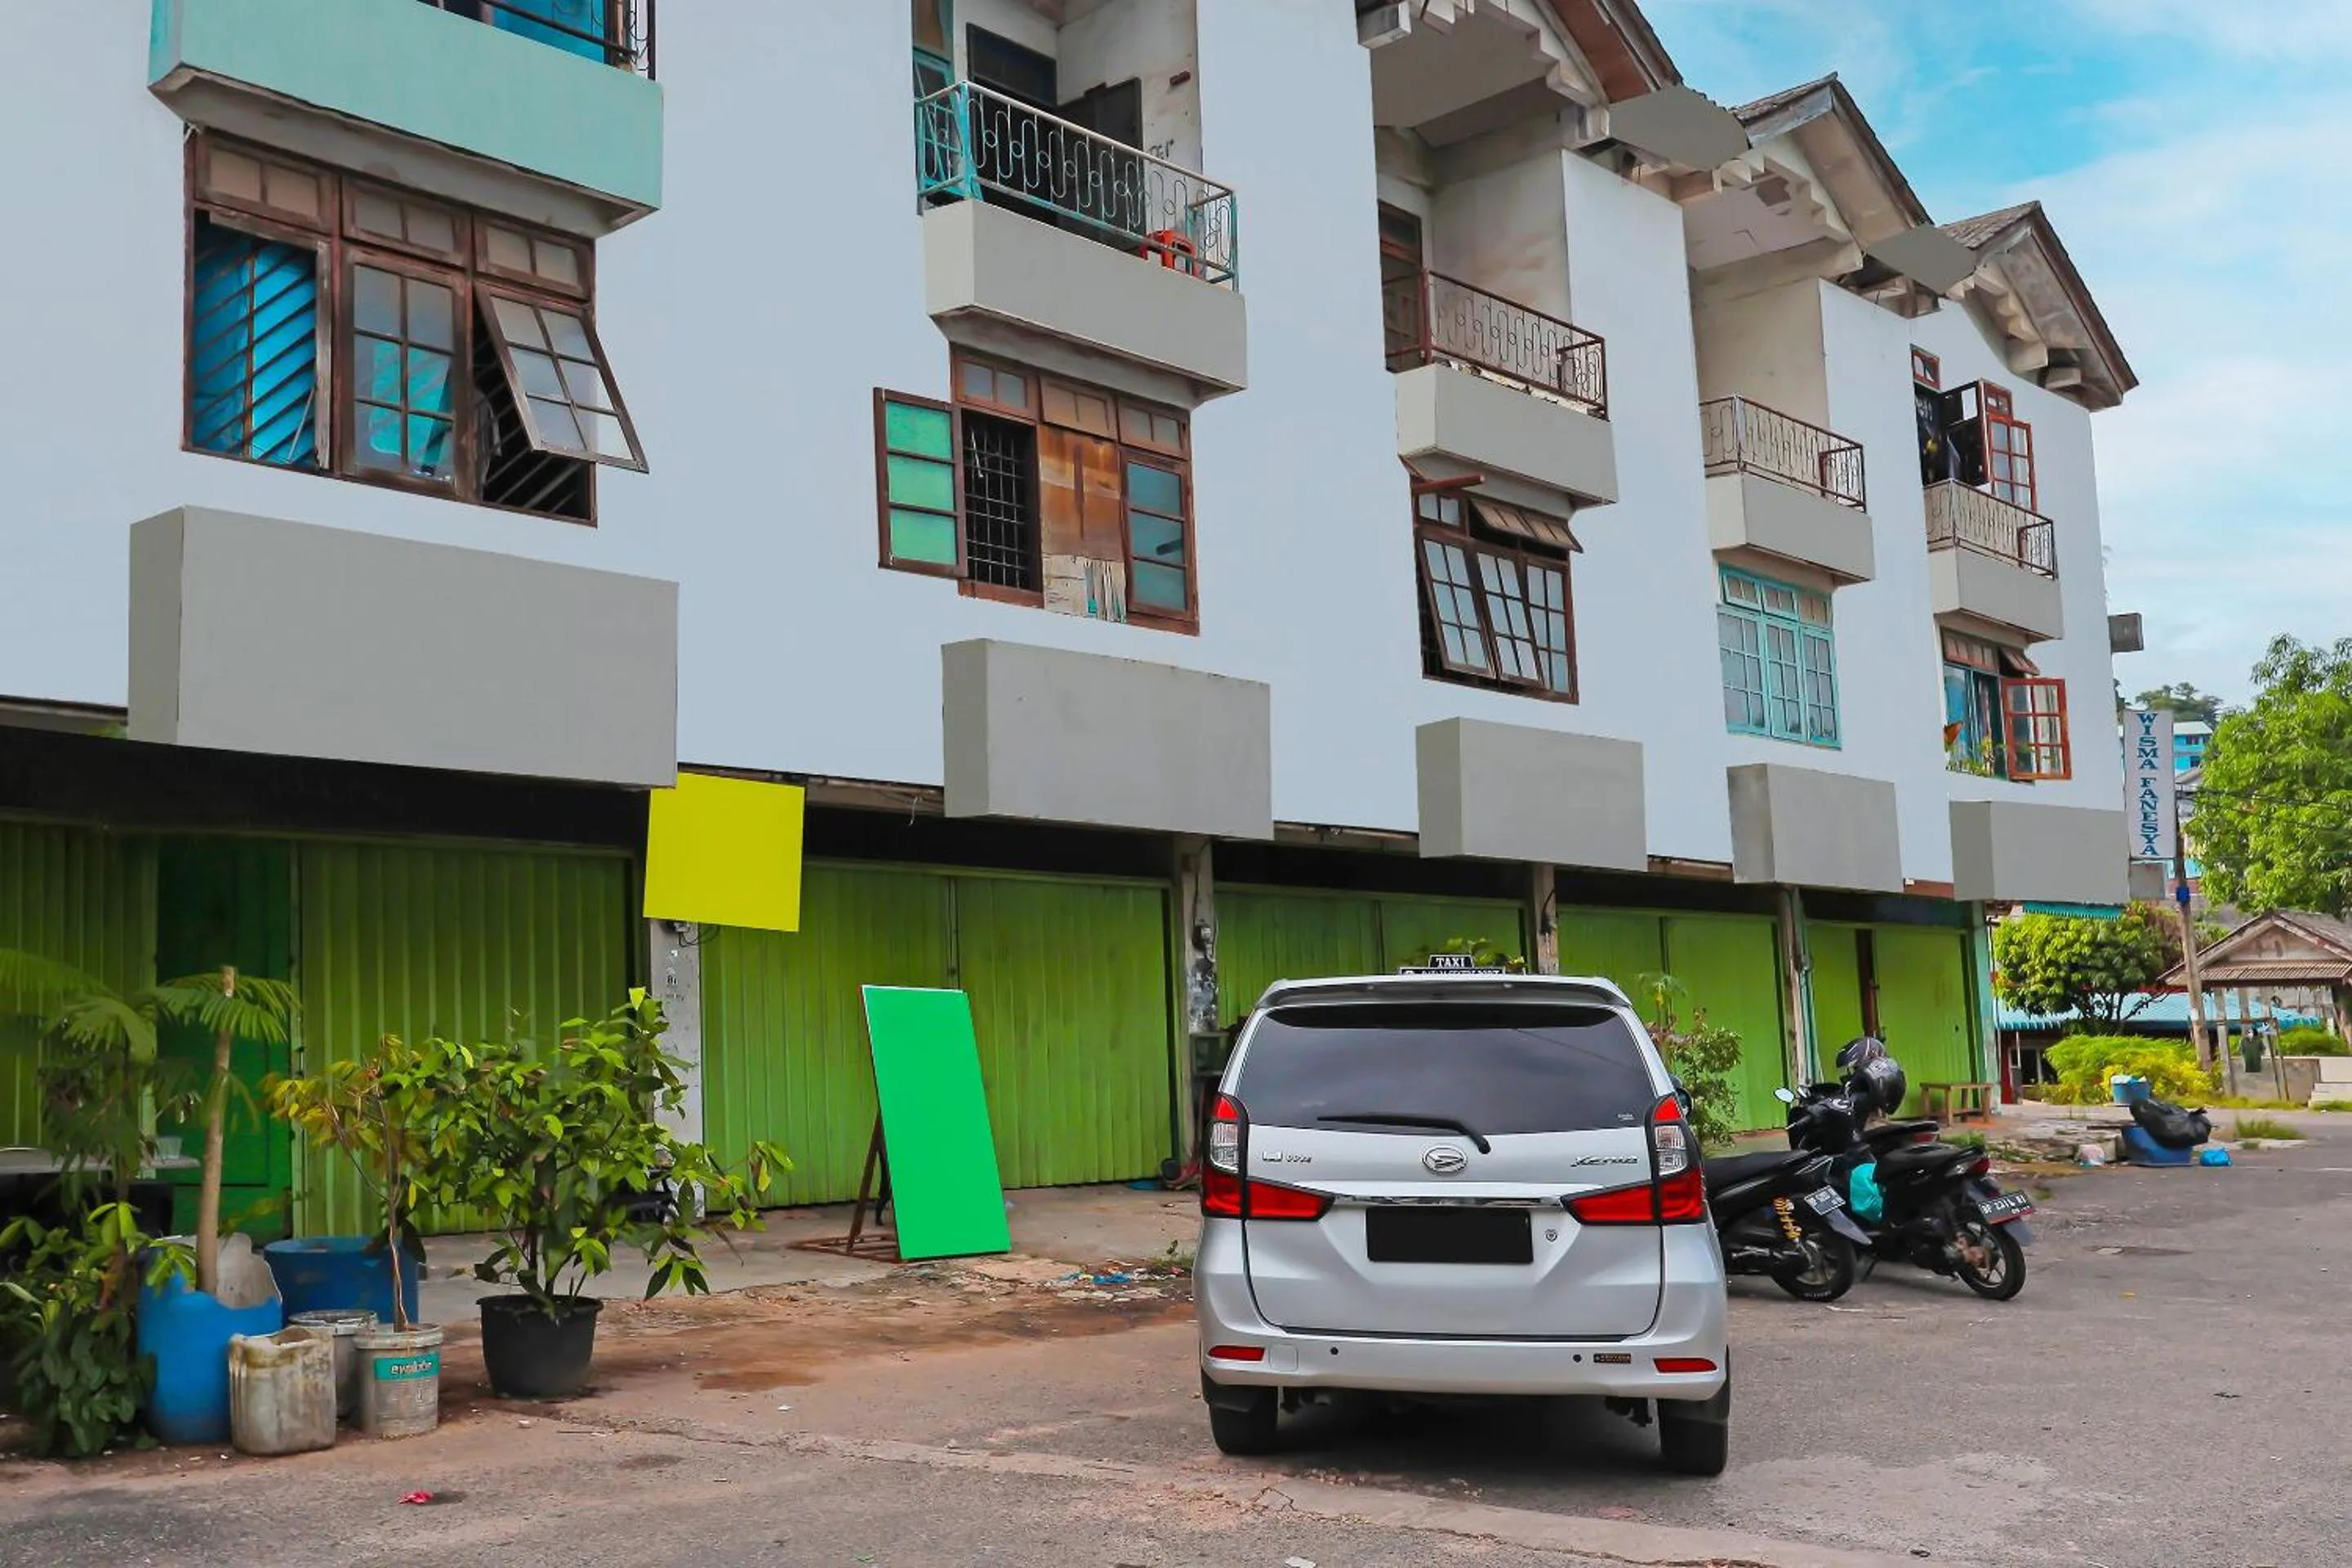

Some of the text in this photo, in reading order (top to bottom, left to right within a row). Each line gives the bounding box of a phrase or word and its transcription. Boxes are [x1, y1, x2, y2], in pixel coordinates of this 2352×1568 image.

[2136, 713, 2162, 856] WISMA FANESYA
[1436, 957, 1465, 969] TAXI
